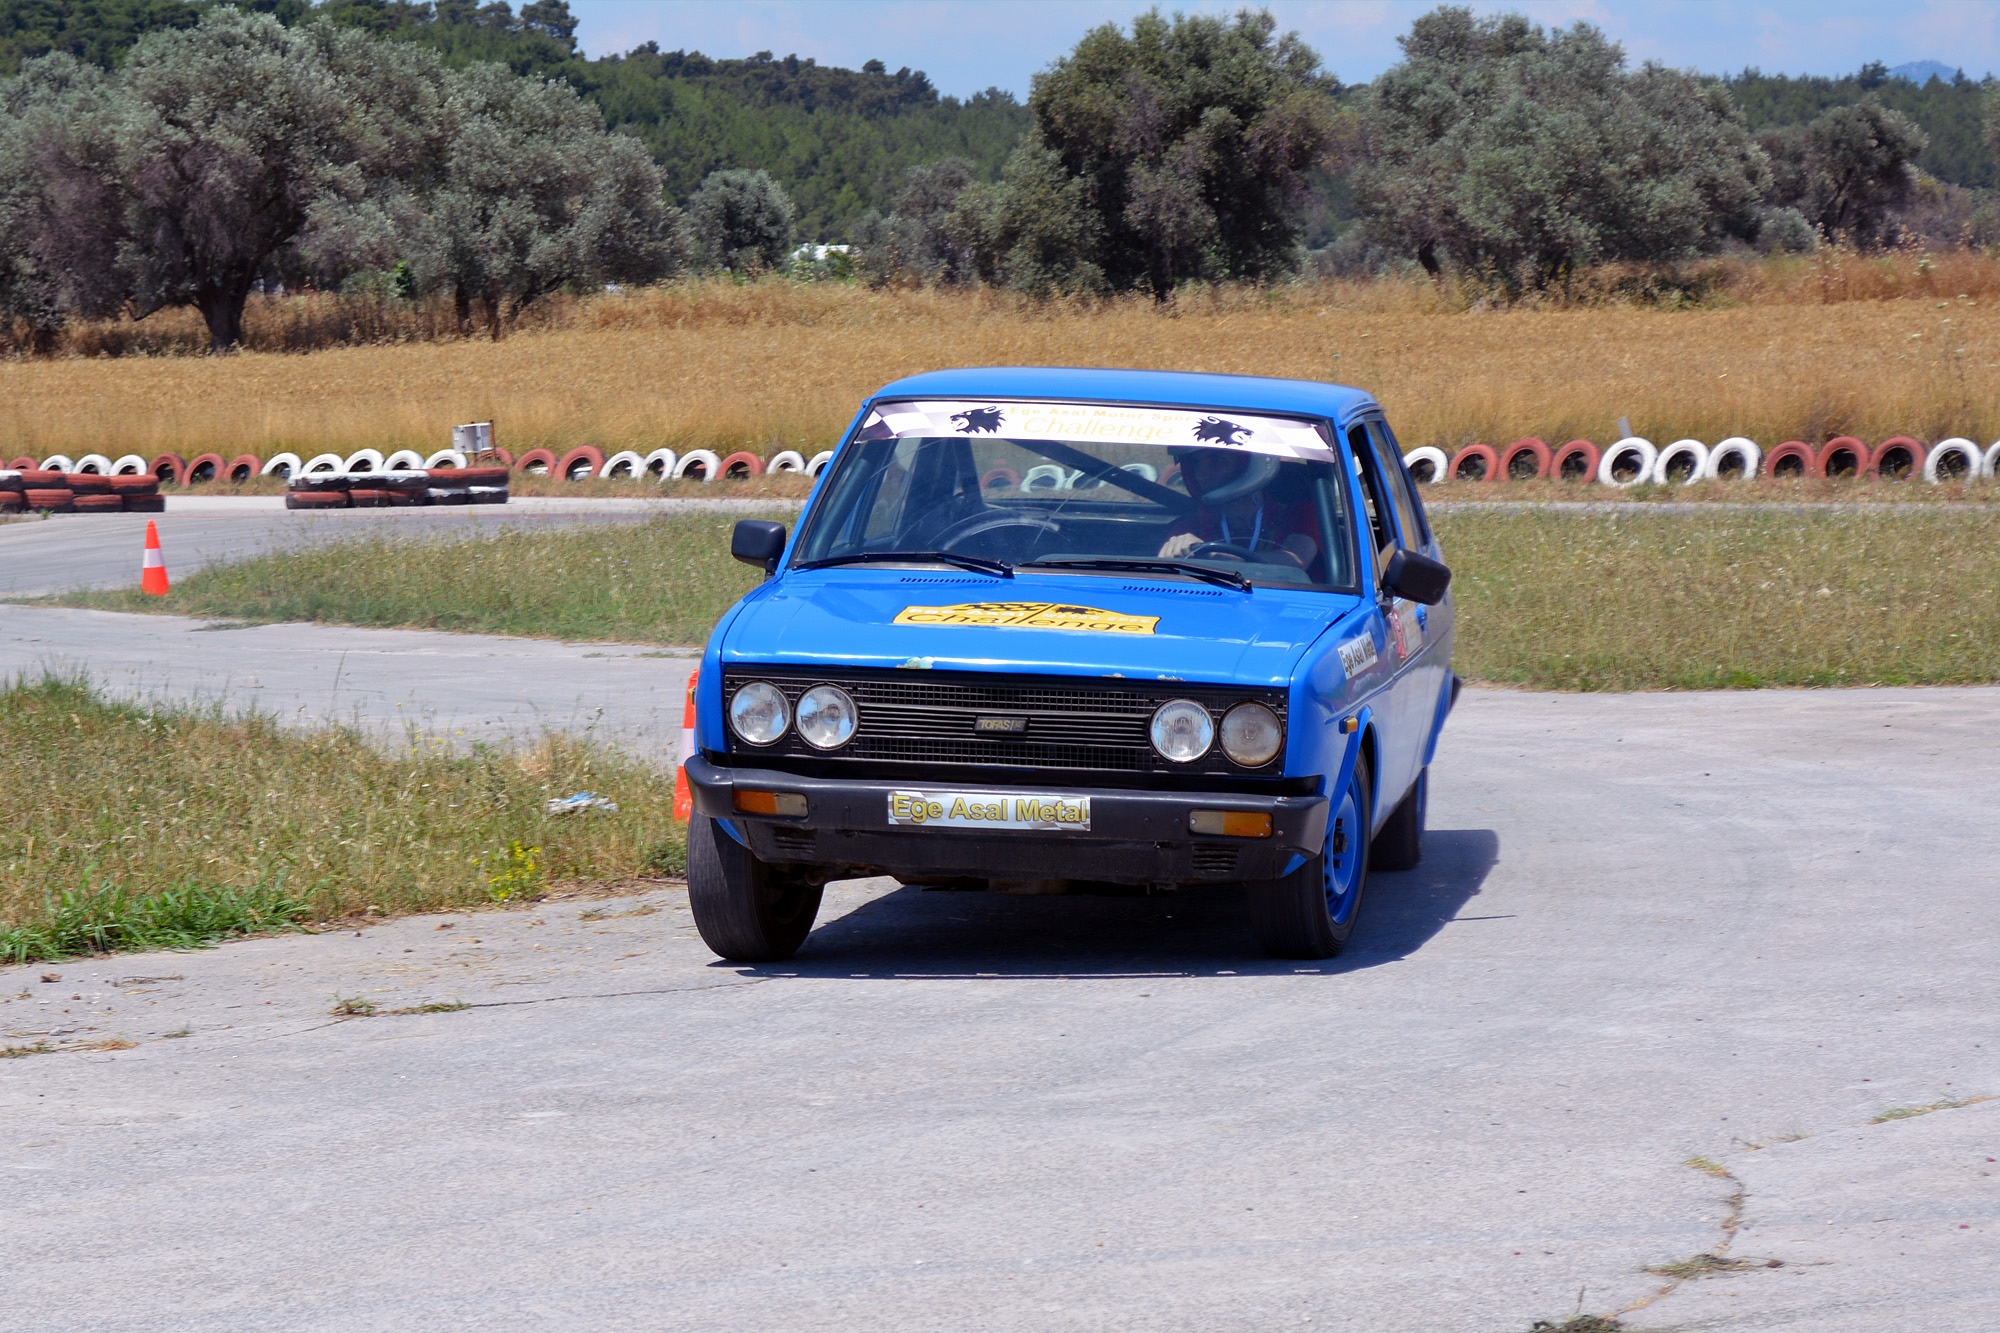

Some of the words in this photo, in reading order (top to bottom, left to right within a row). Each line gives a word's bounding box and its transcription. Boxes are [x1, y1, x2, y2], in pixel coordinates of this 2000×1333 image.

[1094, 409, 1144, 419] Motor
[1023, 416, 1174, 442] Challenge
[906, 613, 1144, 632] Challenge
[892, 795, 943, 823] Ege
[949, 797, 1009, 821] Asal
[1016, 799, 1087, 822] Metal
